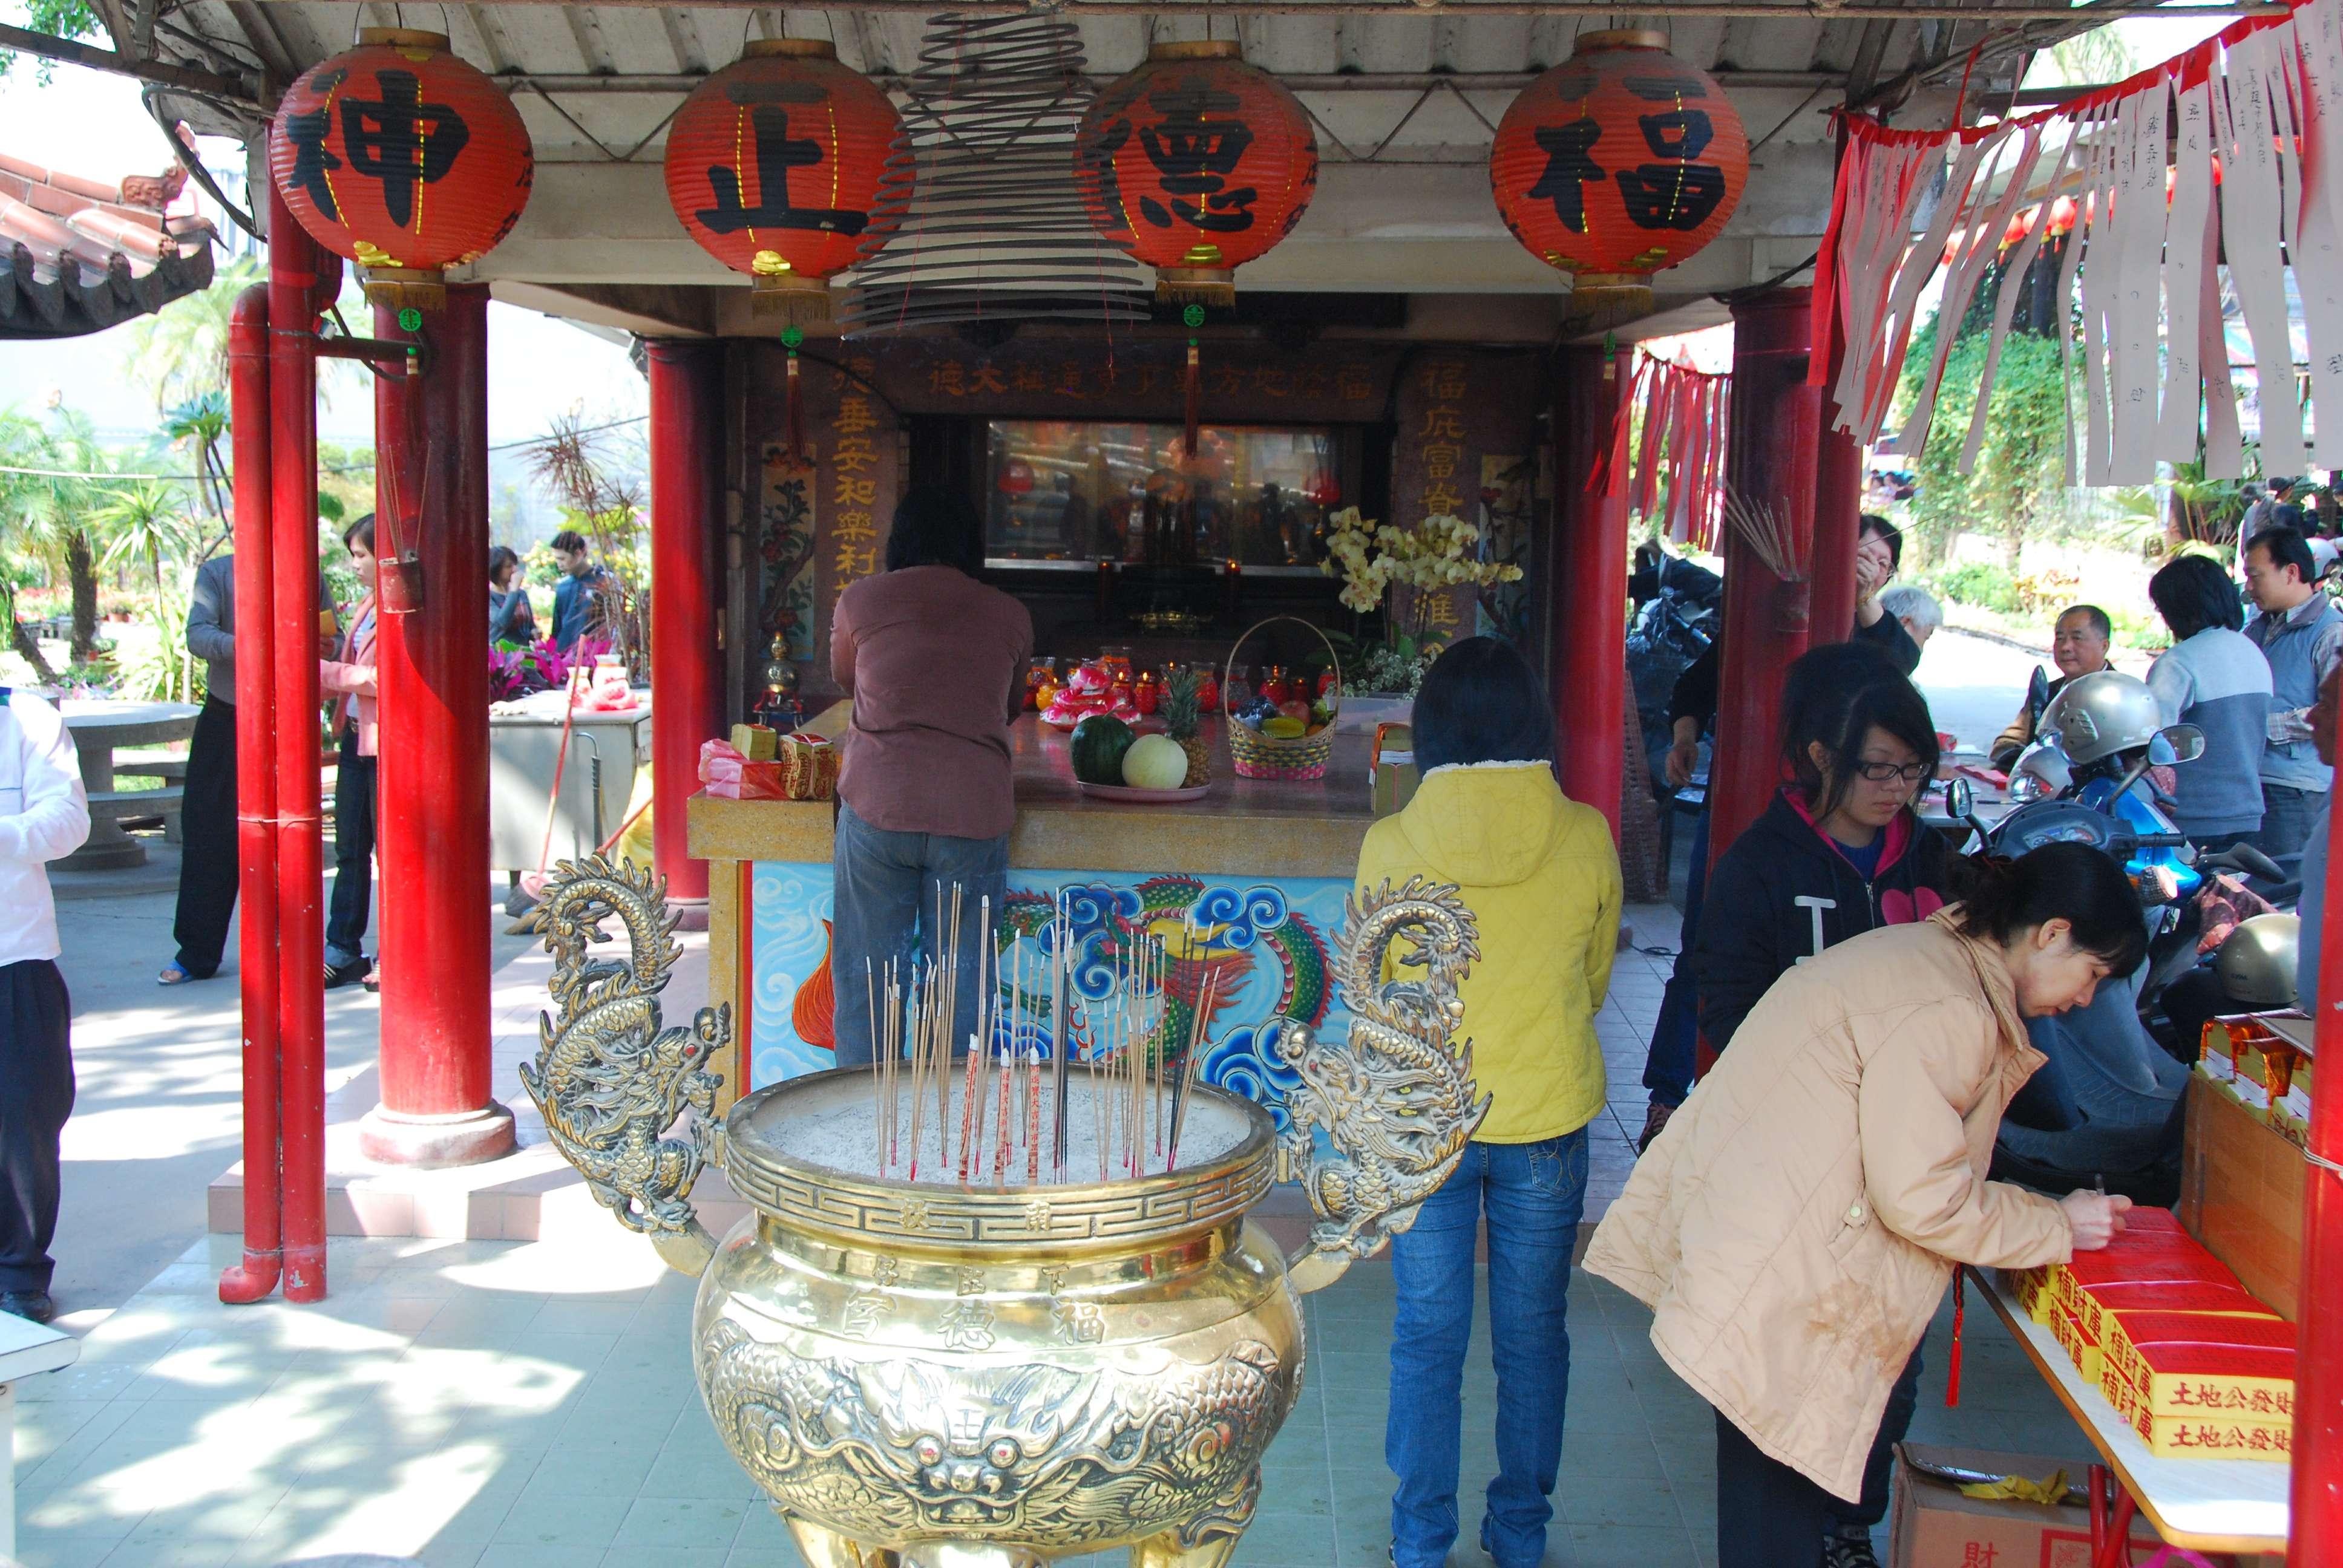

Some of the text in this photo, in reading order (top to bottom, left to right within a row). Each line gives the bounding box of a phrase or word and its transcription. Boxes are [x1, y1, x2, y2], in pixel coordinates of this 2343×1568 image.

[286, 68, 470, 227] 神
[695, 82, 872, 236] 正
[1082, 74, 1258, 232] 德
[1522, 77, 1726, 232] 福
